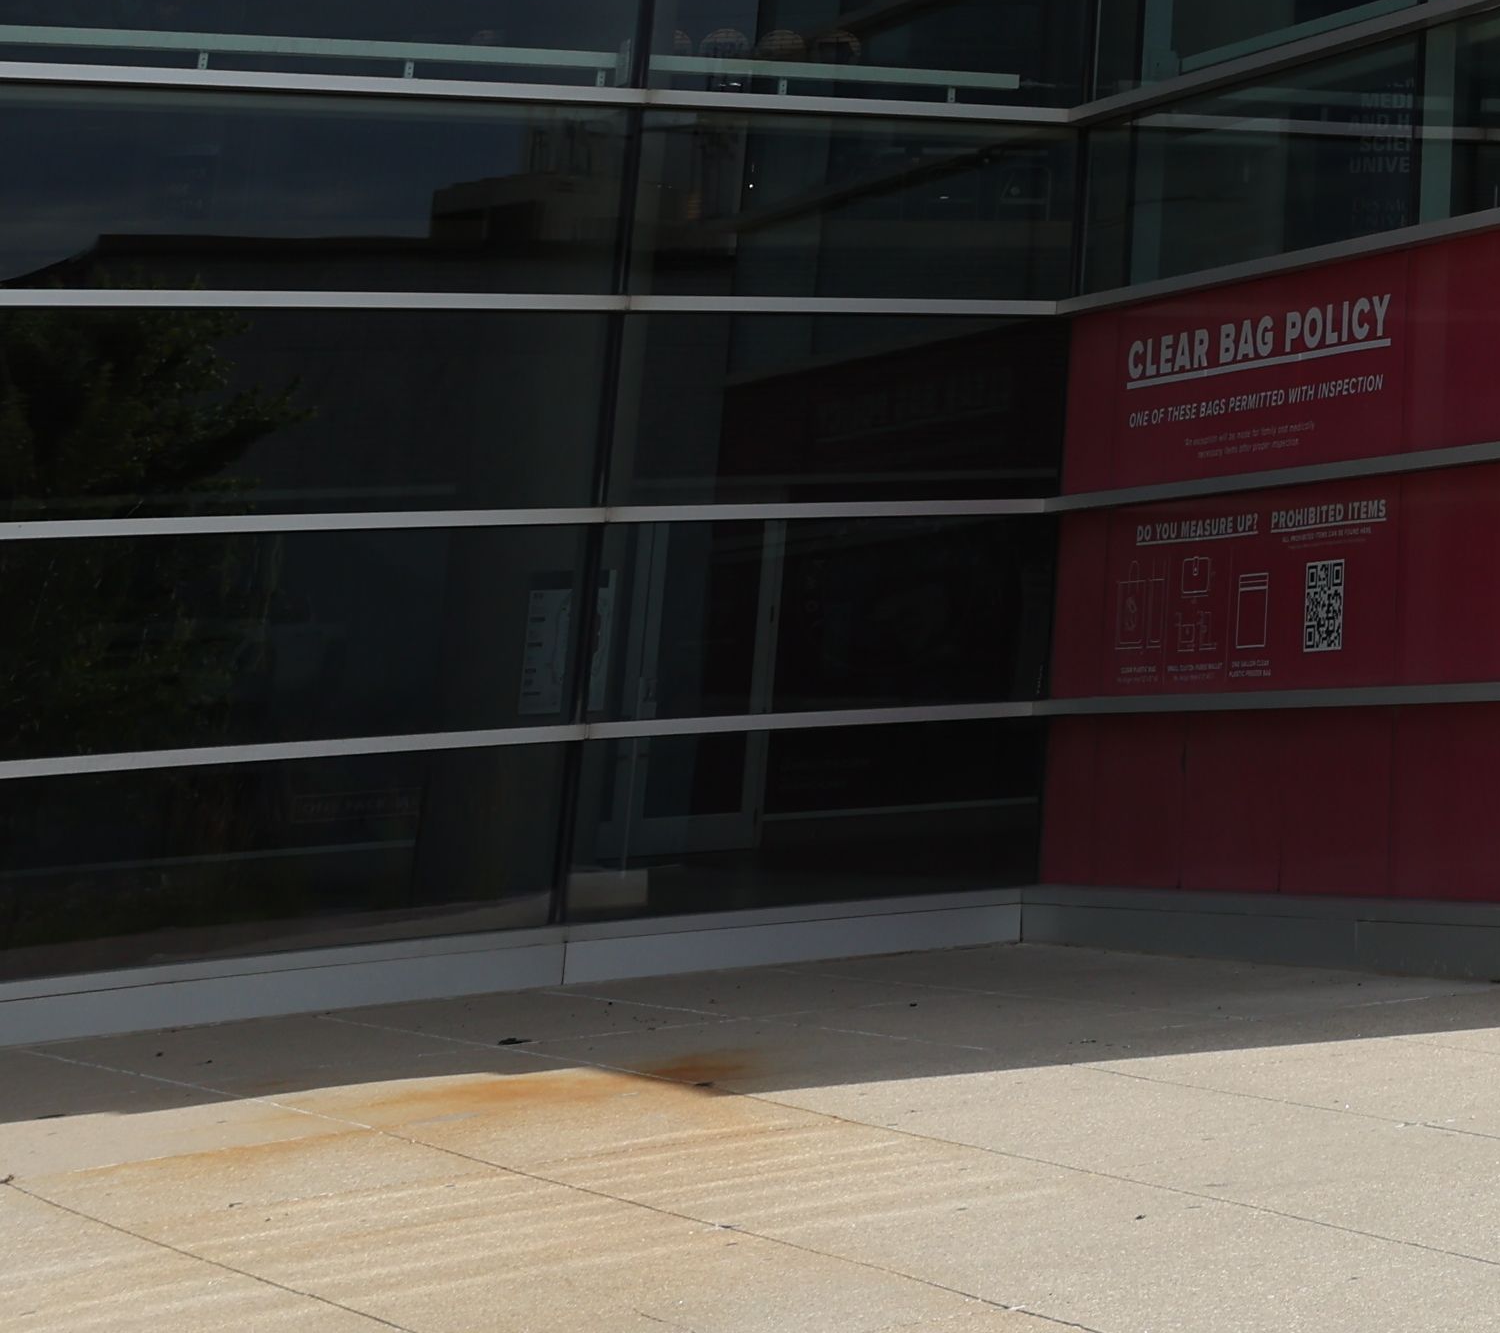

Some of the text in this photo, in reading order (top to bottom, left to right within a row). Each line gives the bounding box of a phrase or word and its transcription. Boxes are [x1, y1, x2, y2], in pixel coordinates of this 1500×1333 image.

[1127, 294, 1392, 380] CLEAR BAG POLICY
[1129, 375, 1384, 429] ONE OF THESE BAGS PERMITTED WITH INSPECTION
[1136, 512, 1259, 542] DO YOU MEASURE UP?
[1271, 499, 1387, 530] PROHIBITED ITEMS
